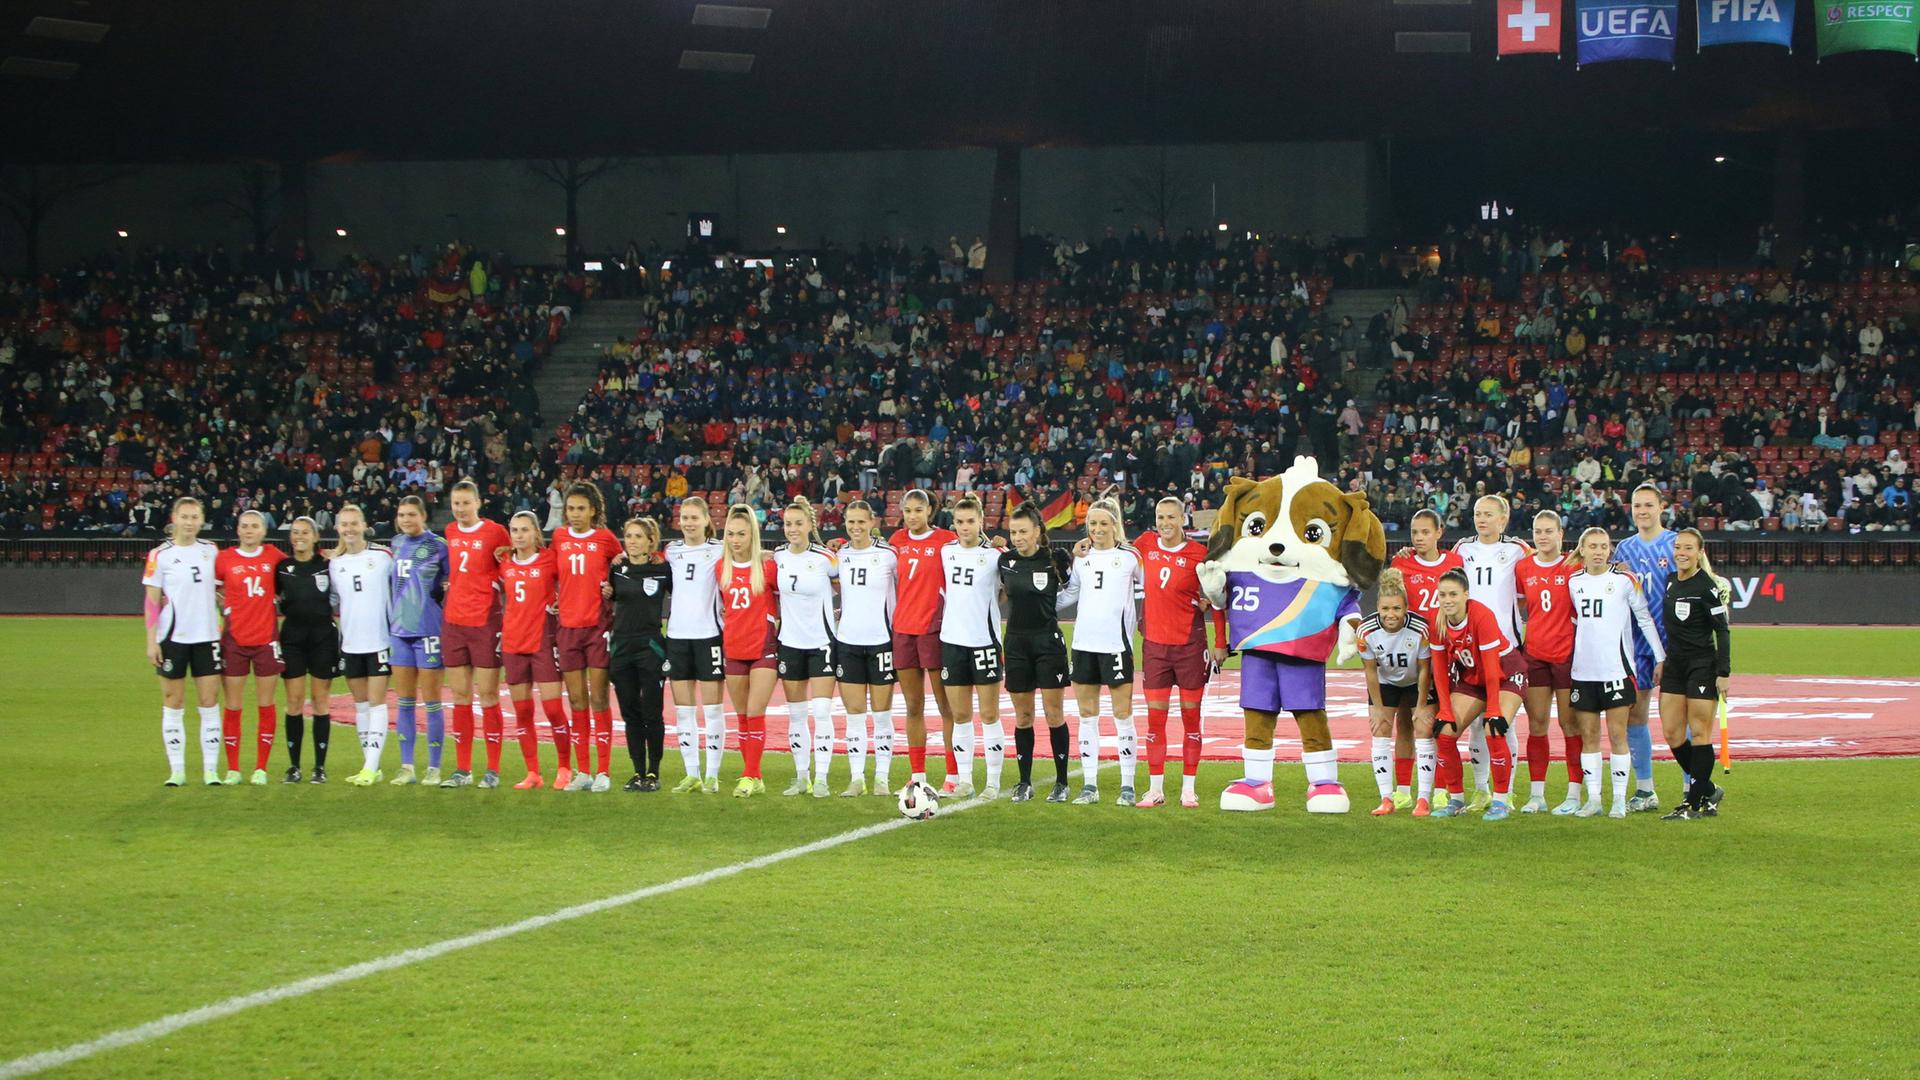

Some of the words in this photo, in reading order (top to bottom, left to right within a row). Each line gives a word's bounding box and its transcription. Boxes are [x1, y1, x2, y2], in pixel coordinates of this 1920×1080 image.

[1712, 0, 1780, 23] FIFA
[1847, 5, 1913, 18] RESPECT
[1581, 8, 1671, 37] UEFA
[396, 560, 412, 577] 12
[459, 552, 468, 572] 2
[568, 553, 586, 575] 11
[685, 563, 695, 580] 9
[908, 558, 919, 580] 7
[191, 566, 201, 583] 2
[352, 575, 362, 592] 6
[789, 575, 798, 592] 7
[850, 567, 867, 586] 19
[952, 567, 974, 586] 25
[1094, 571, 1103, 589] 3
[1160, 566, 1170, 589] 9
[1475, 566, 1492, 586] 11
[243, 576, 265, 597] 14
[515, 581, 526, 602] 5
[729, 587, 750, 609] 23
[1231, 585, 1260, 612] 25
[1540, 589, 1552, 612] 8
[1581, 598, 1603, 618] 20
[422, 636, 441, 653] 12
[820, 645, 831, 663] 7
[711, 646, 722, 666] 9
[876, 652, 893, 672] 19
[974, 648, 998, 670] 25
[1111, 653, 1124, 671] 3
[1203, 649, 1210, 668] 9
[1386, 653, 1408, 668] 16
[1454, 649, 1475, 668] 18
